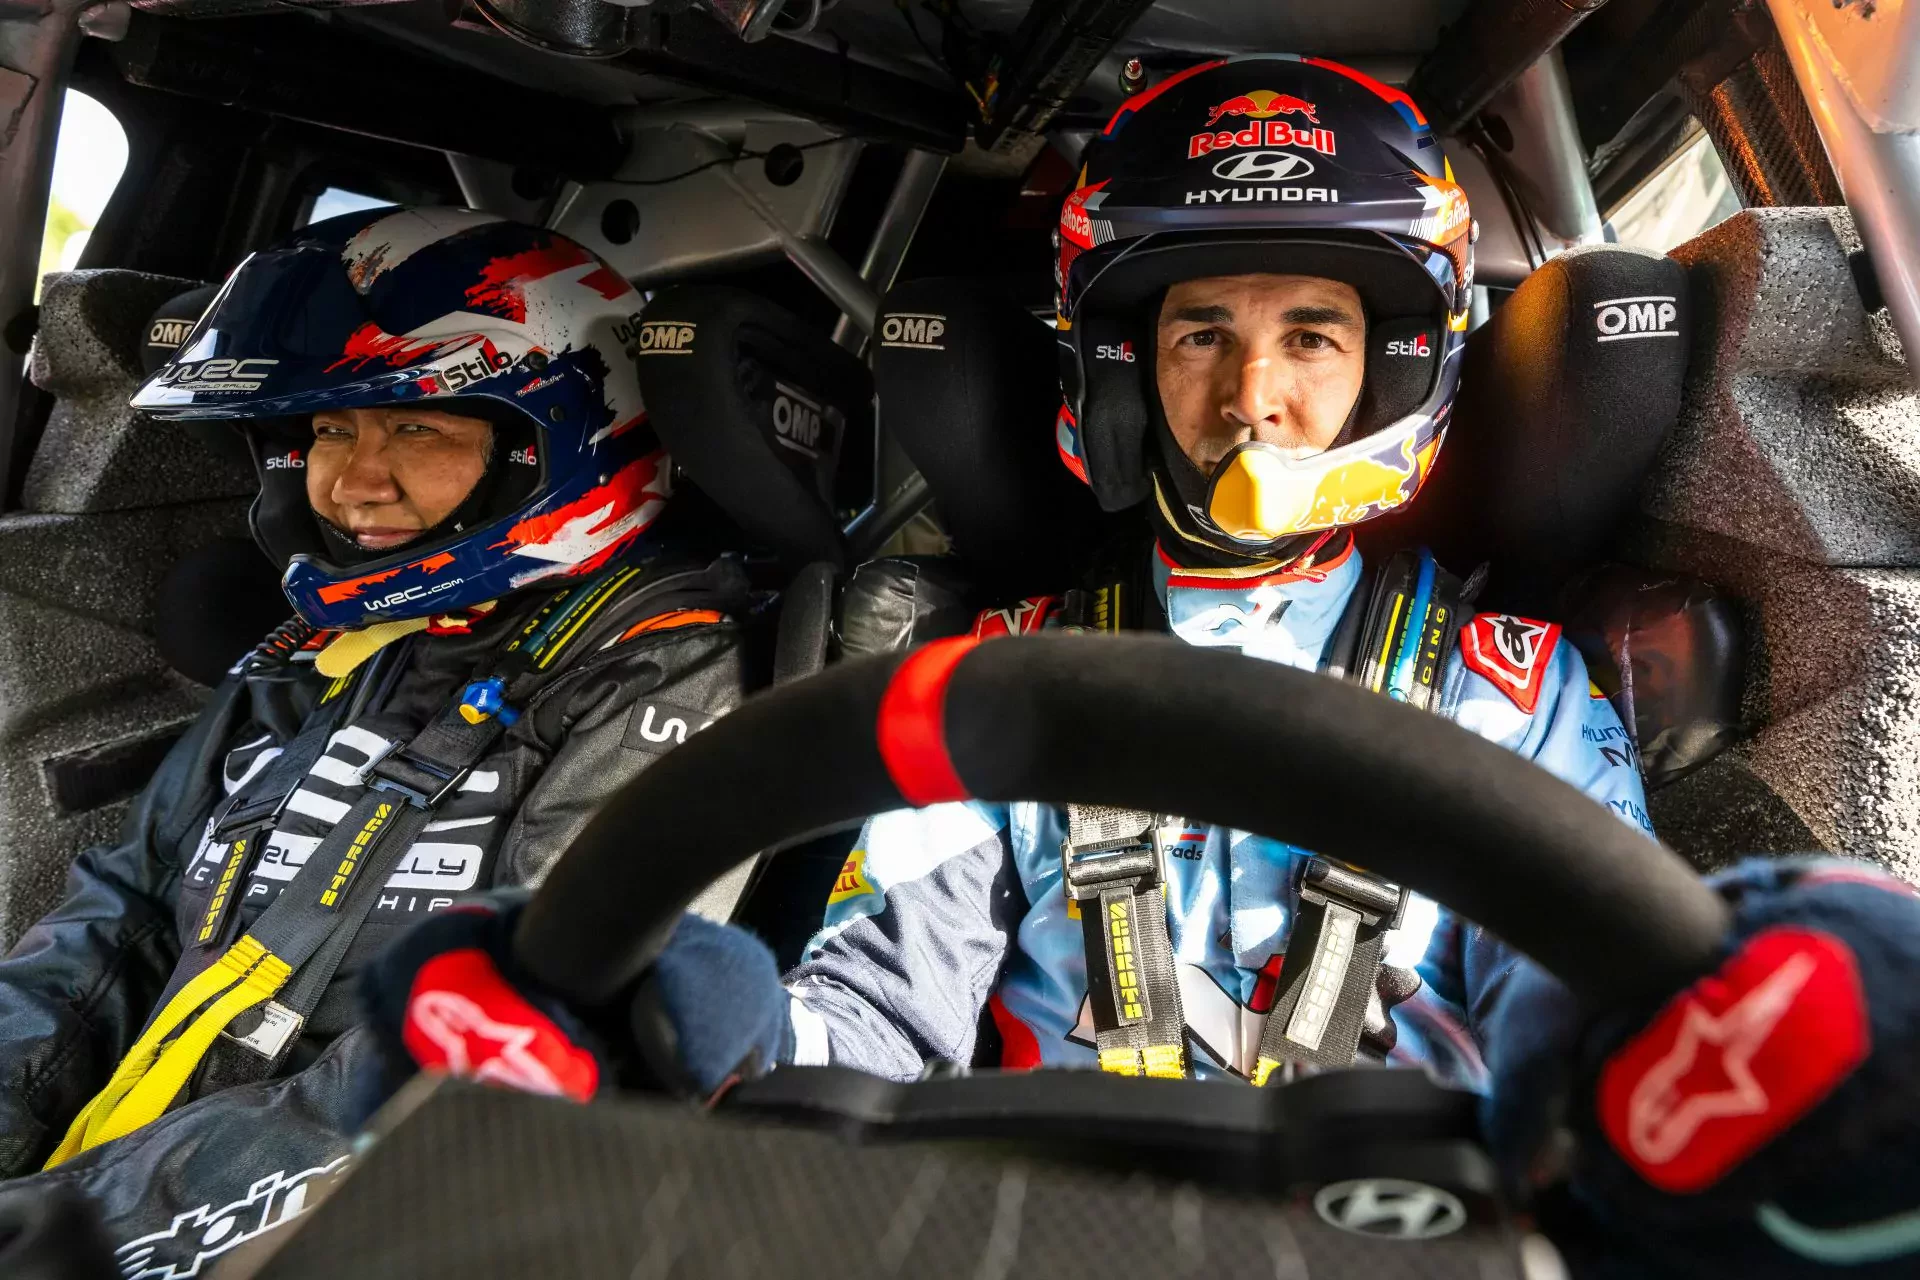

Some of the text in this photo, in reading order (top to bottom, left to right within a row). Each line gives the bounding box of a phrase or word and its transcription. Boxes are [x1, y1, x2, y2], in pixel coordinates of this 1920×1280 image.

[1188, 121, 1336, 159] Red Bull
[1185, 187, 1339, 204] HYUNDAI
[639, 327, 695, 349] OMP
[883, 318, 945, 343] OMP
[1597, 303, 1677, 335] OMP
[160, 359, 280, 382] WRC
[444, 345, 514, 391] Stilo
[773, 396, 820, 446] OMP
[320, 803, 392, 907] SCHROTH
[199, 839, 247, 942] SCHROTH
[1110, 902, 1143, 1019] SCHROTH
